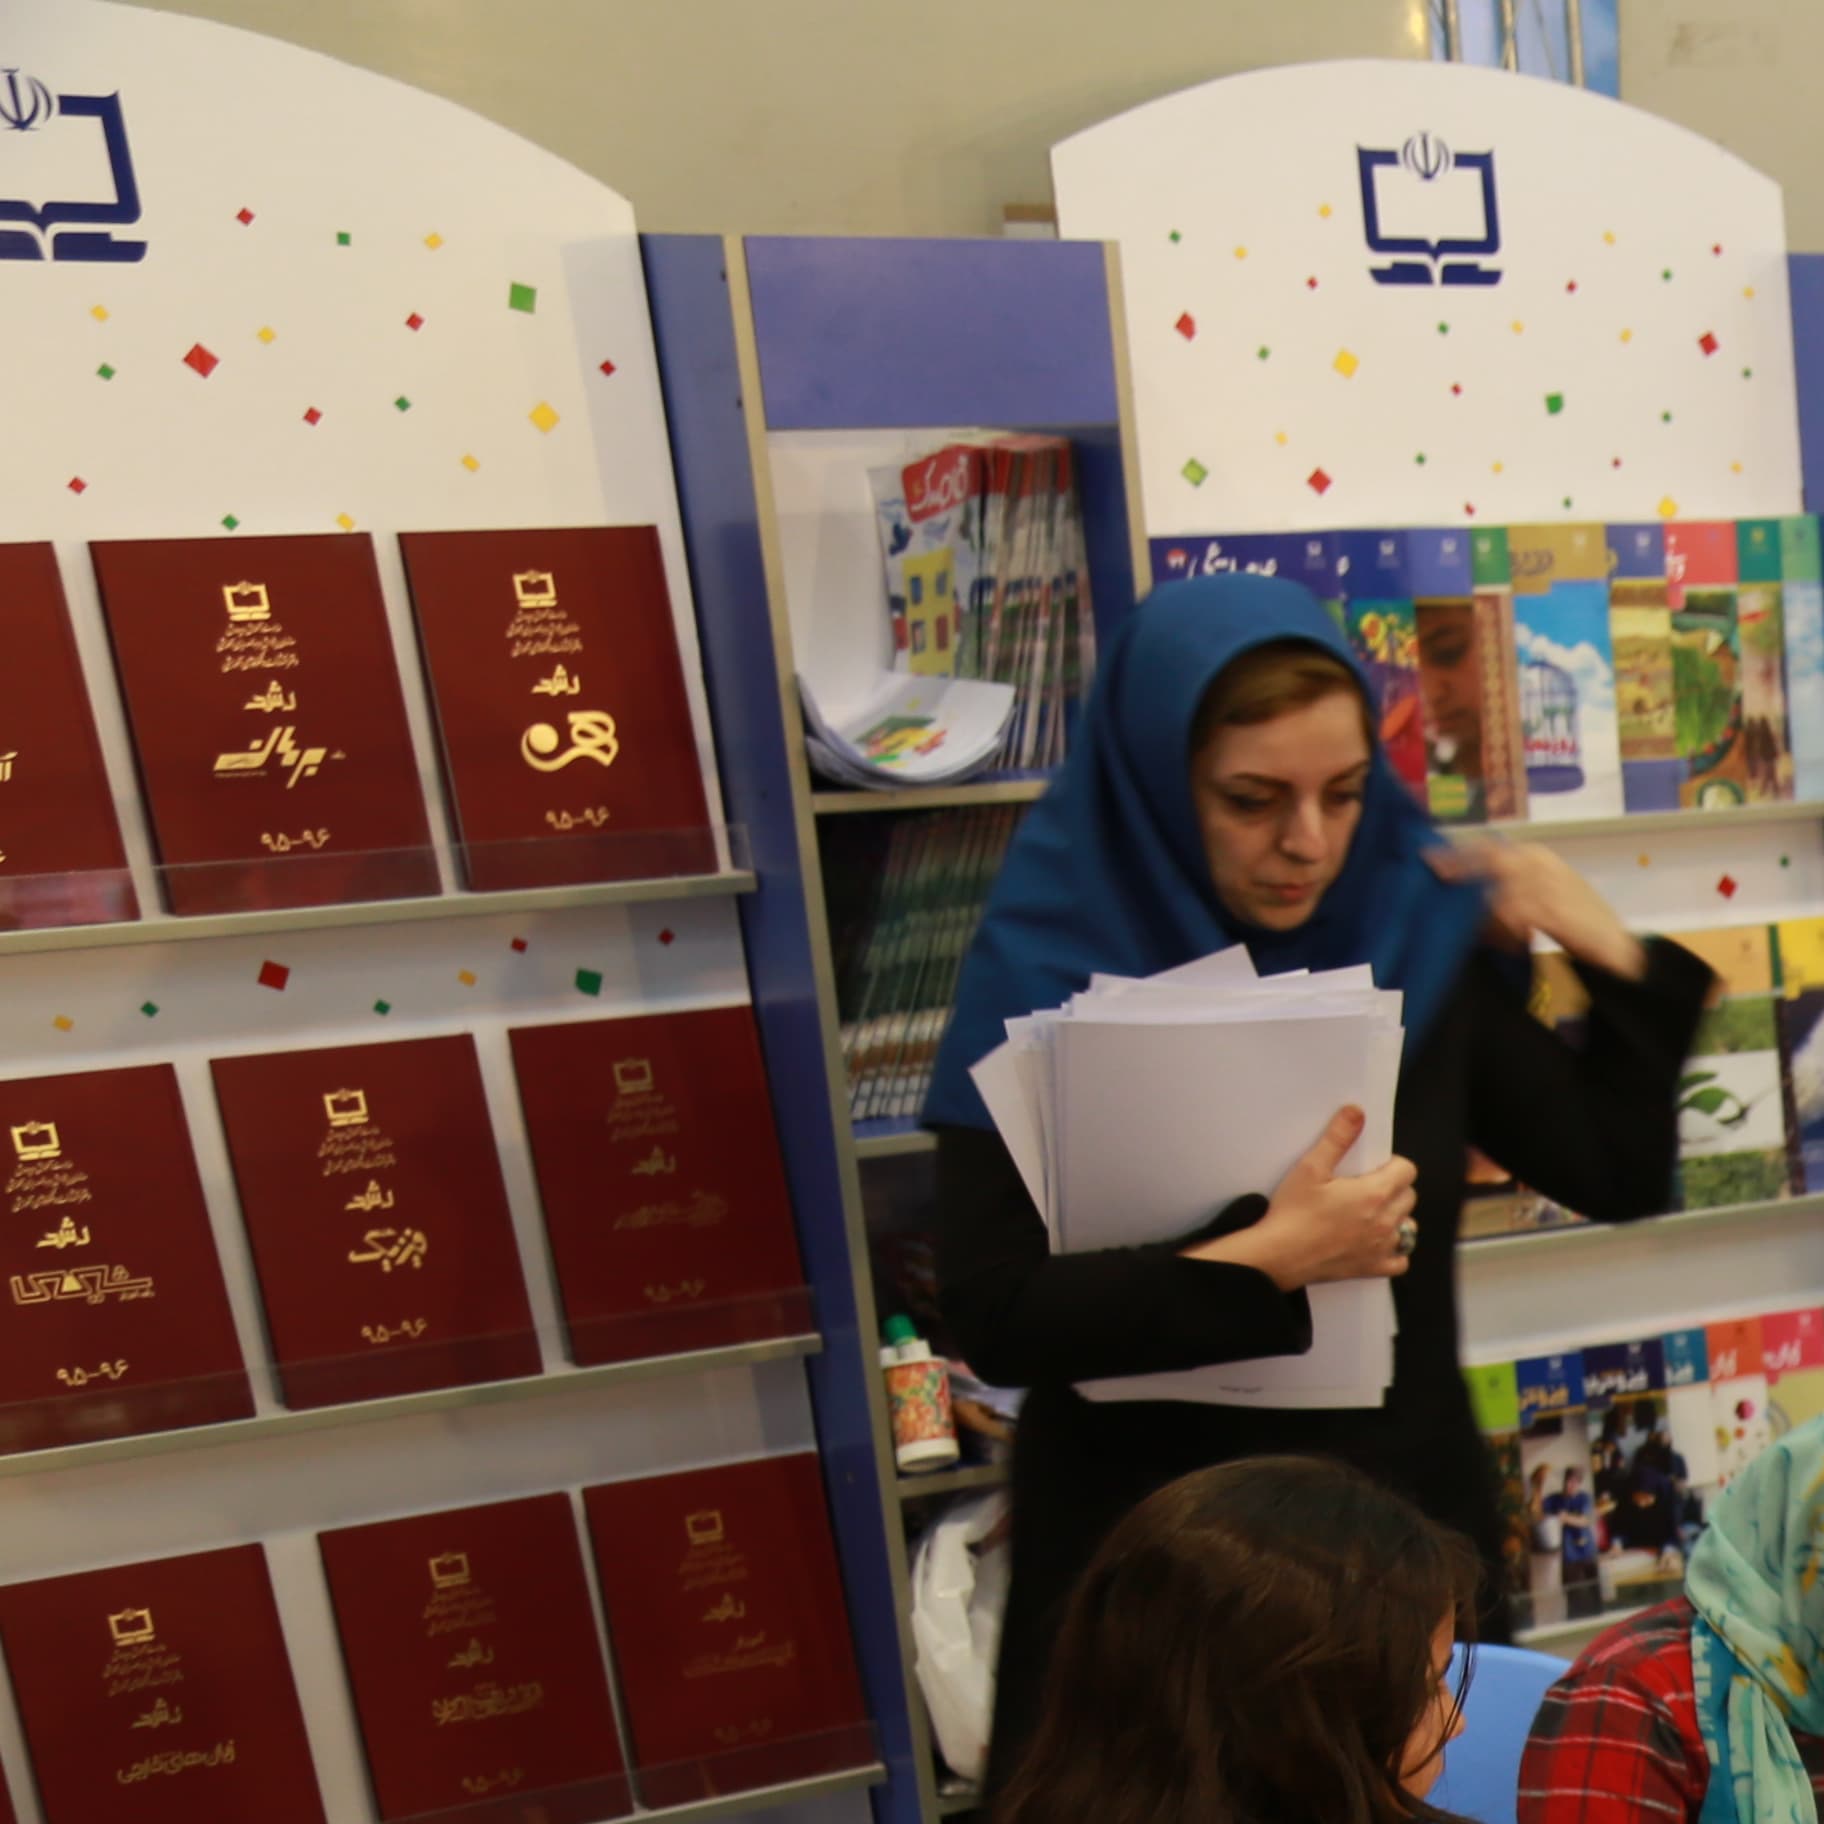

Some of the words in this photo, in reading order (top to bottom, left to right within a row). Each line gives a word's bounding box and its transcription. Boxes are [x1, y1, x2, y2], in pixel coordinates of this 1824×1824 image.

[531, 664, 581, 696] رشد
[243, 680, 296, 713] رشد
[345, 1180, 394, 1211] رشد
[36, 1216, 91, 1249] رشد
[348, 1227, 428, 1273] فیزیک
[130, 1697, 183, 1728] رشد
